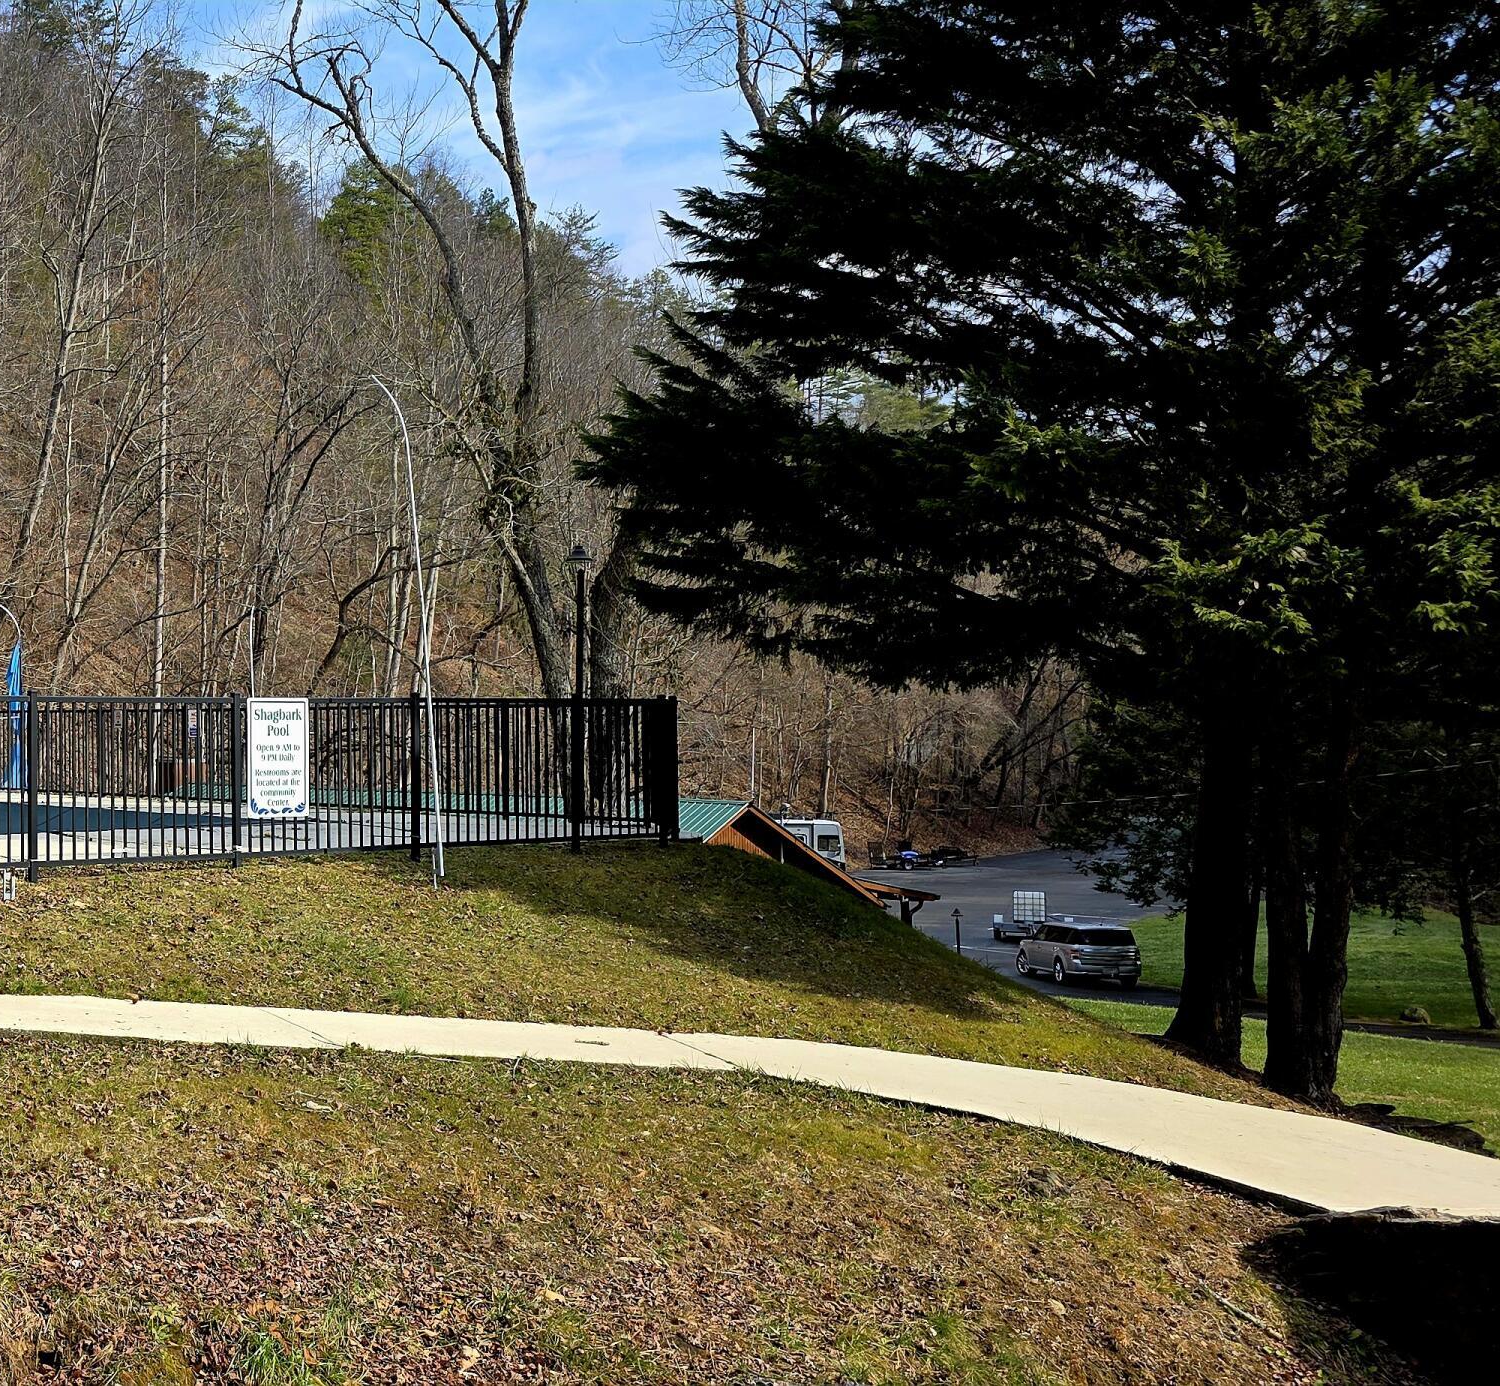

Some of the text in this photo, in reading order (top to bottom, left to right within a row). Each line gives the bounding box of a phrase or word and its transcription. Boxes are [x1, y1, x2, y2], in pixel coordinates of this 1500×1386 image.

[254, 708, 302, 723] Shagbark
[267, 725, 289, 736] Pool
[256, 744, 274, 753] Open
[279, 754, 295, 762] Daily
[256, 778, 280, 786] located
[291, 778, 300, 786] the
